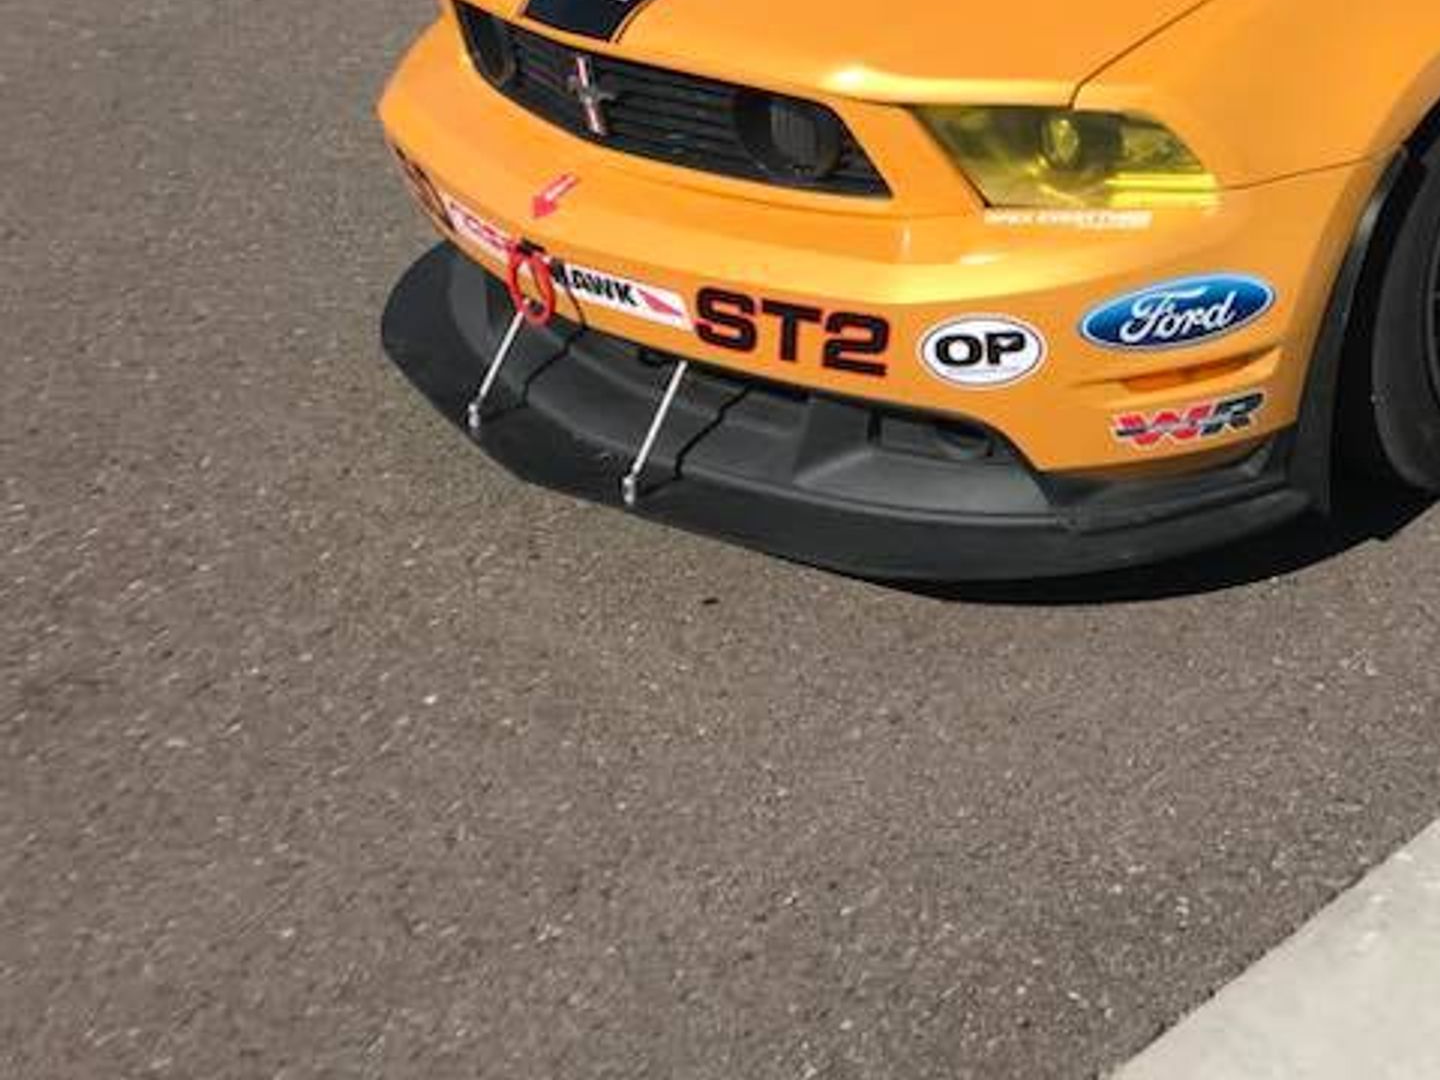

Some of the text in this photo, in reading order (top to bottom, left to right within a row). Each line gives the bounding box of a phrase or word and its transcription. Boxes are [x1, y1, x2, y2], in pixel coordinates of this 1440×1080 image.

[695, 287, 889, 377] ST2
[1119, 285, 1237, 343] Ford
[935, 331, 1025, 367] OP
